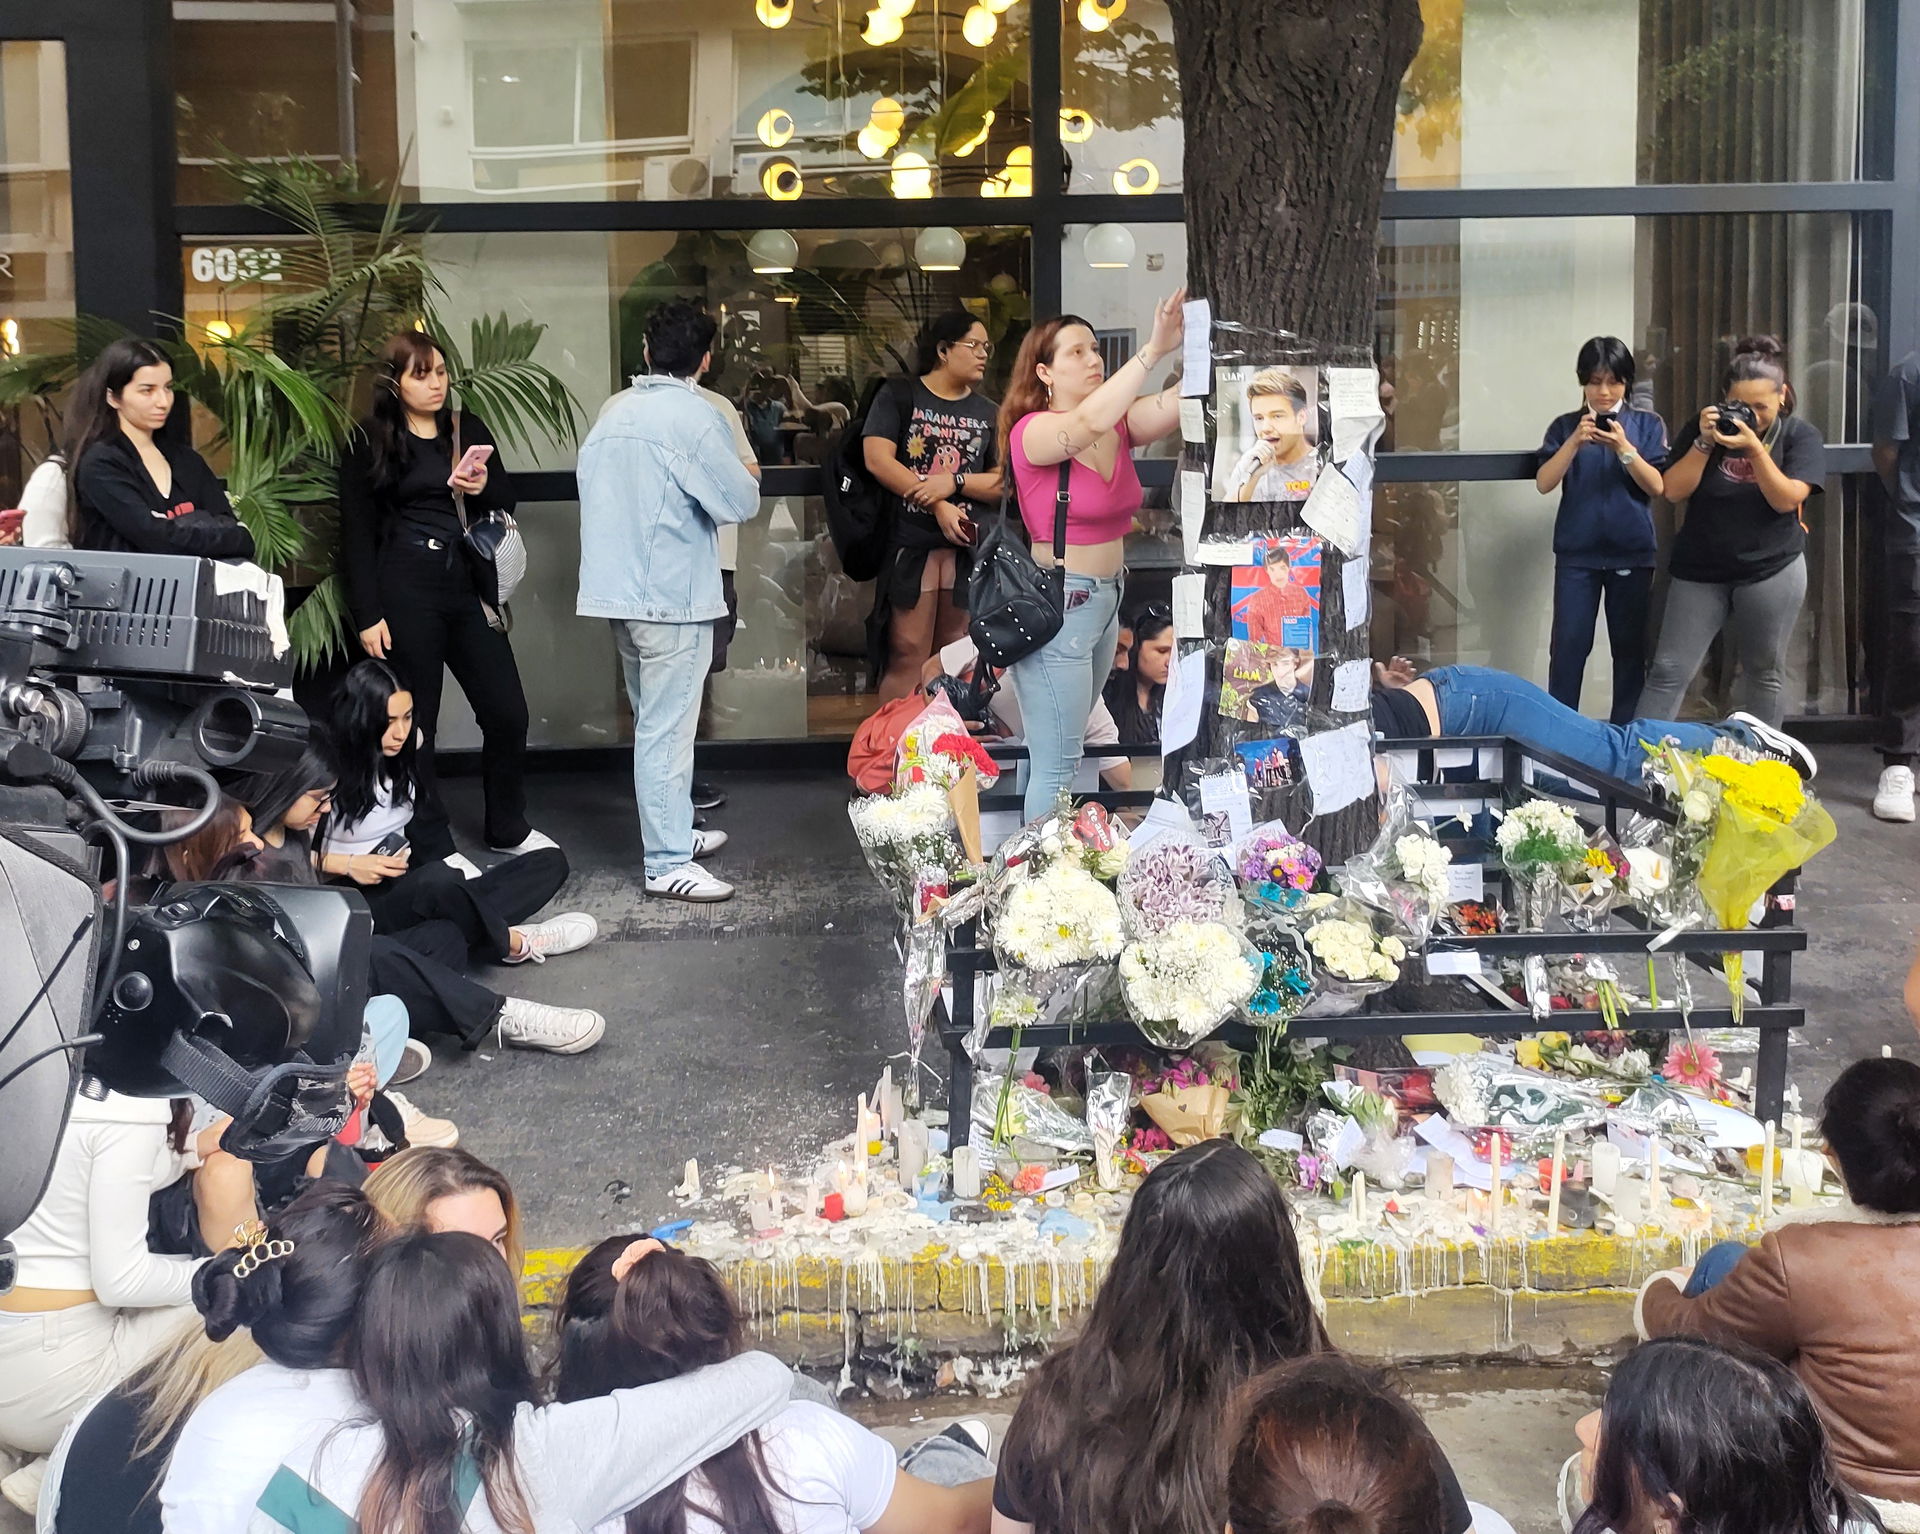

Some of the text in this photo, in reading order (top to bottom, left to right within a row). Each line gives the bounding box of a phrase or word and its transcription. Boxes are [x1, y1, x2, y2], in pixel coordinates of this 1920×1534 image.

[191, 247, 283, 282] 6032
[1086, 806, 1111, 847] Te amo
